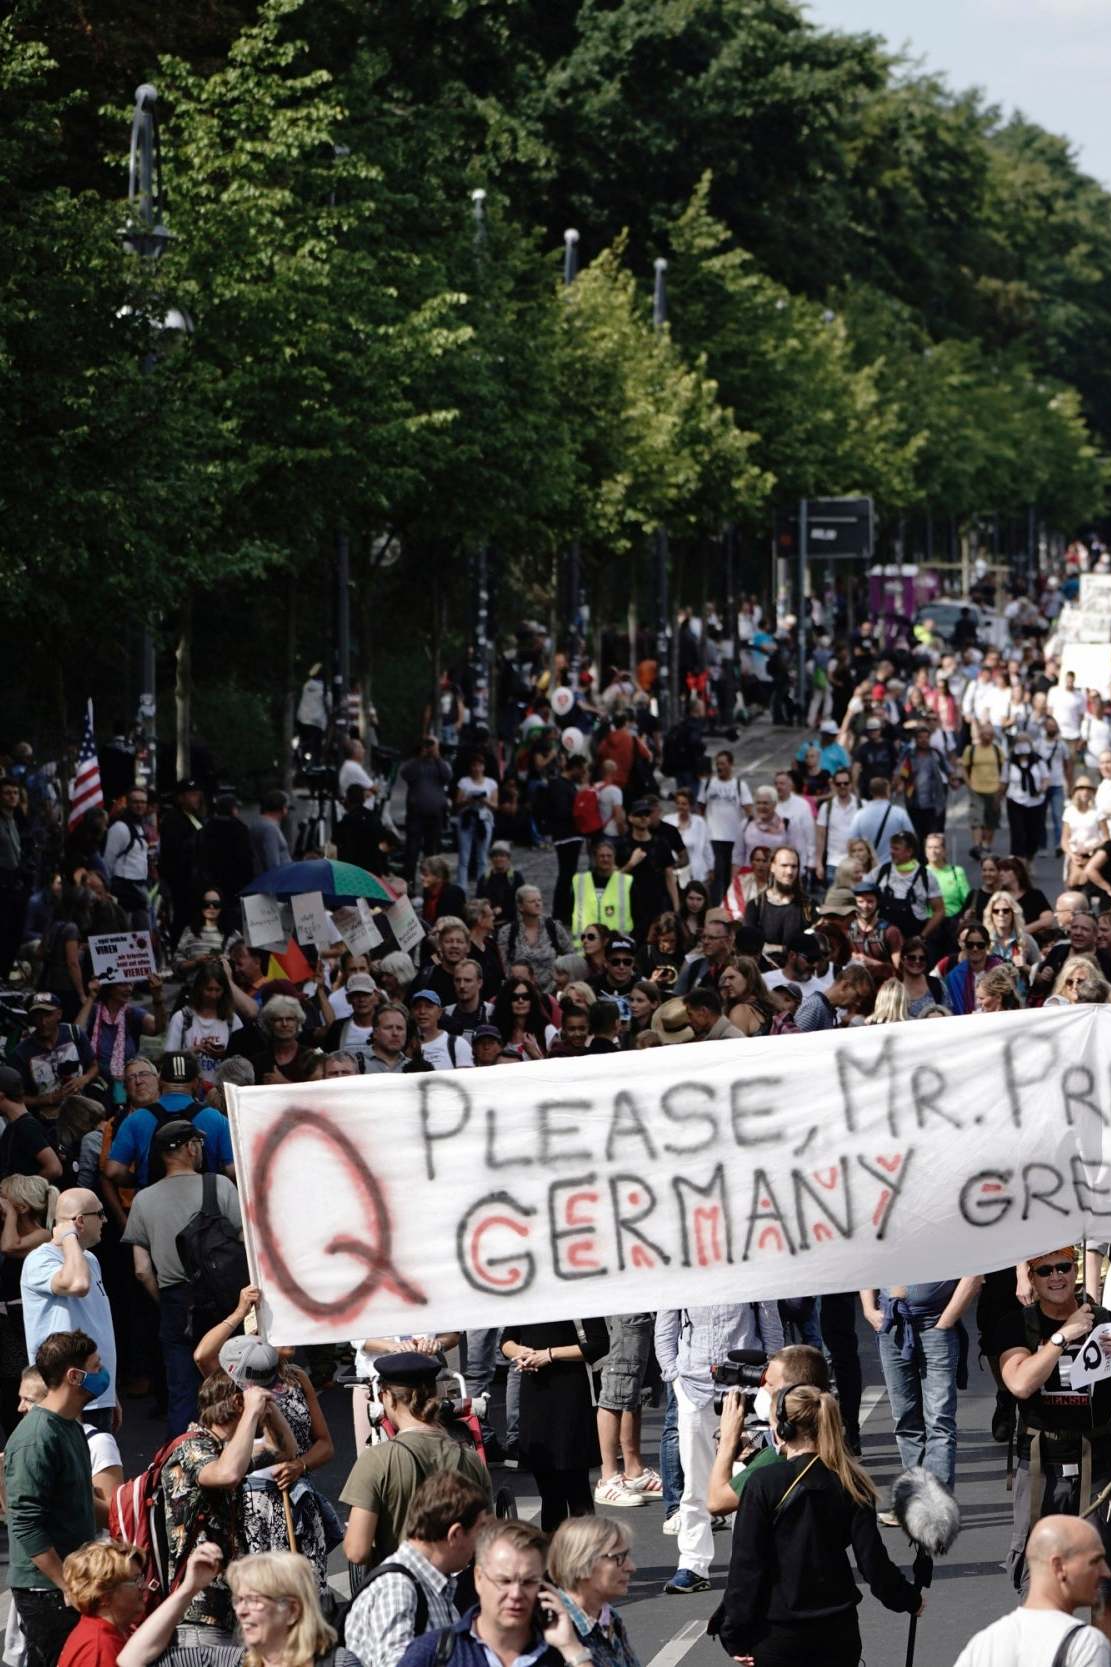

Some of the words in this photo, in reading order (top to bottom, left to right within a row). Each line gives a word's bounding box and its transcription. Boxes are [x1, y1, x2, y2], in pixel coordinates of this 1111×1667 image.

[95, 944, 118, 955] VIREN
[417, 1076, 818, 1180] PLEASE,
[249, 1104, 428, 1325] Q
[457, 1147, 915, 1297] GERMANY
[1083, 1340, 1102, 1371] Q
